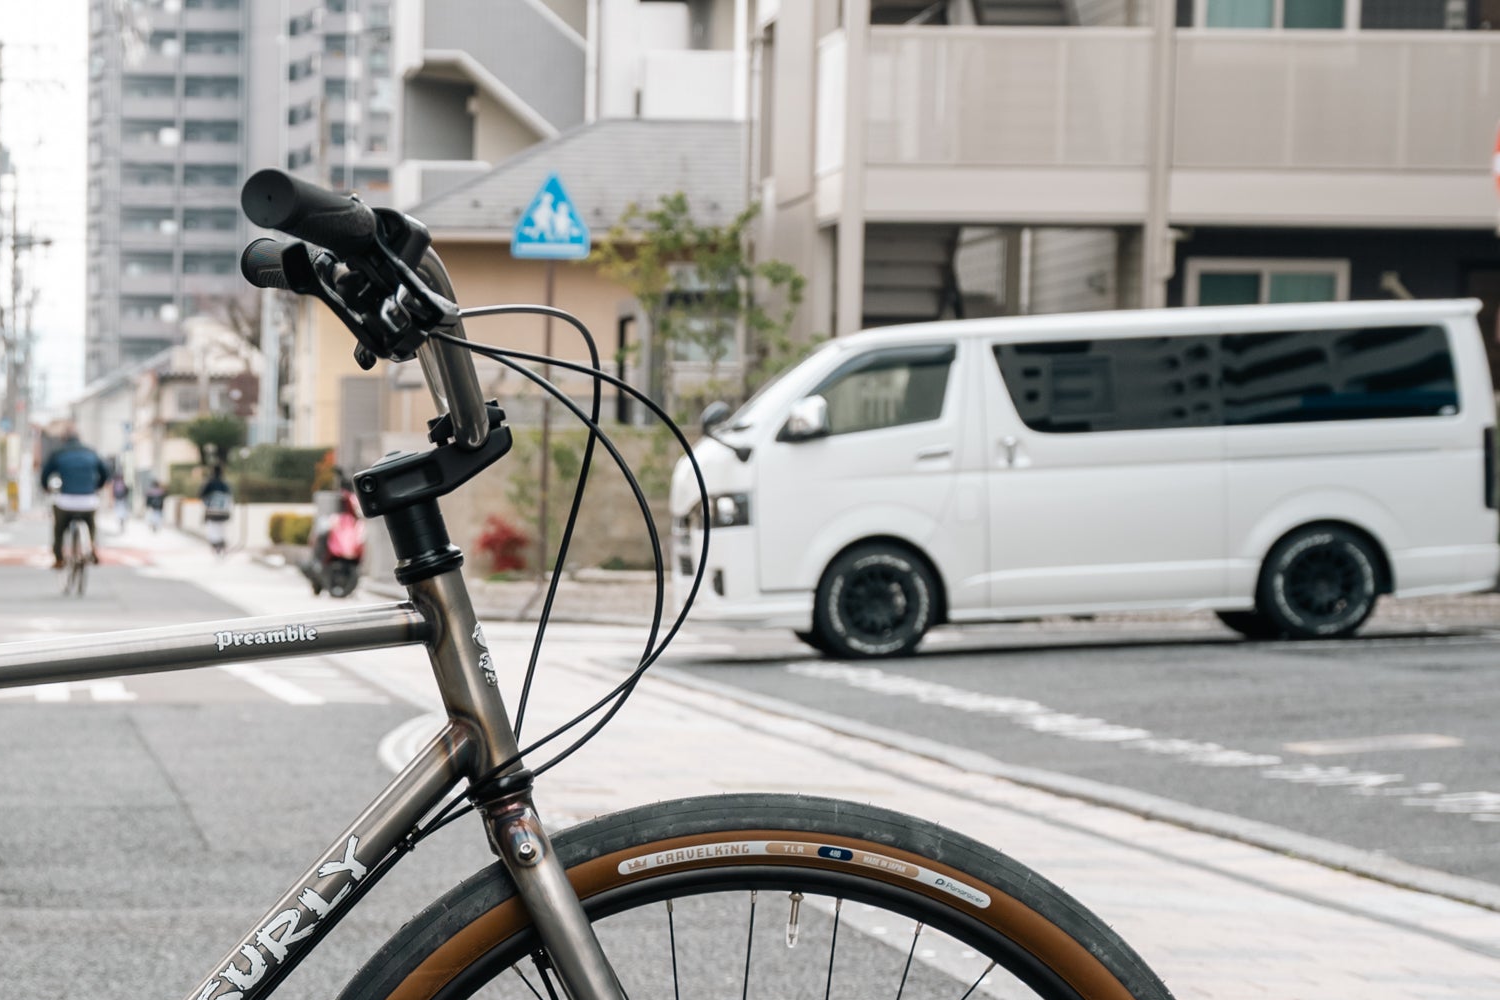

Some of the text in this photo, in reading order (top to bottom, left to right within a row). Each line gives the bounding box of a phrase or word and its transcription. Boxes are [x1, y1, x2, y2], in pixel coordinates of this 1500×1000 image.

[214, 624, 318, 651] Preamble
[783, 845, 805, 854] TLR
[862, 855, 880, 866] MADE
[887, 861, 907, 874] JAPAN
[944, 882, 985, 904] Panaracer
